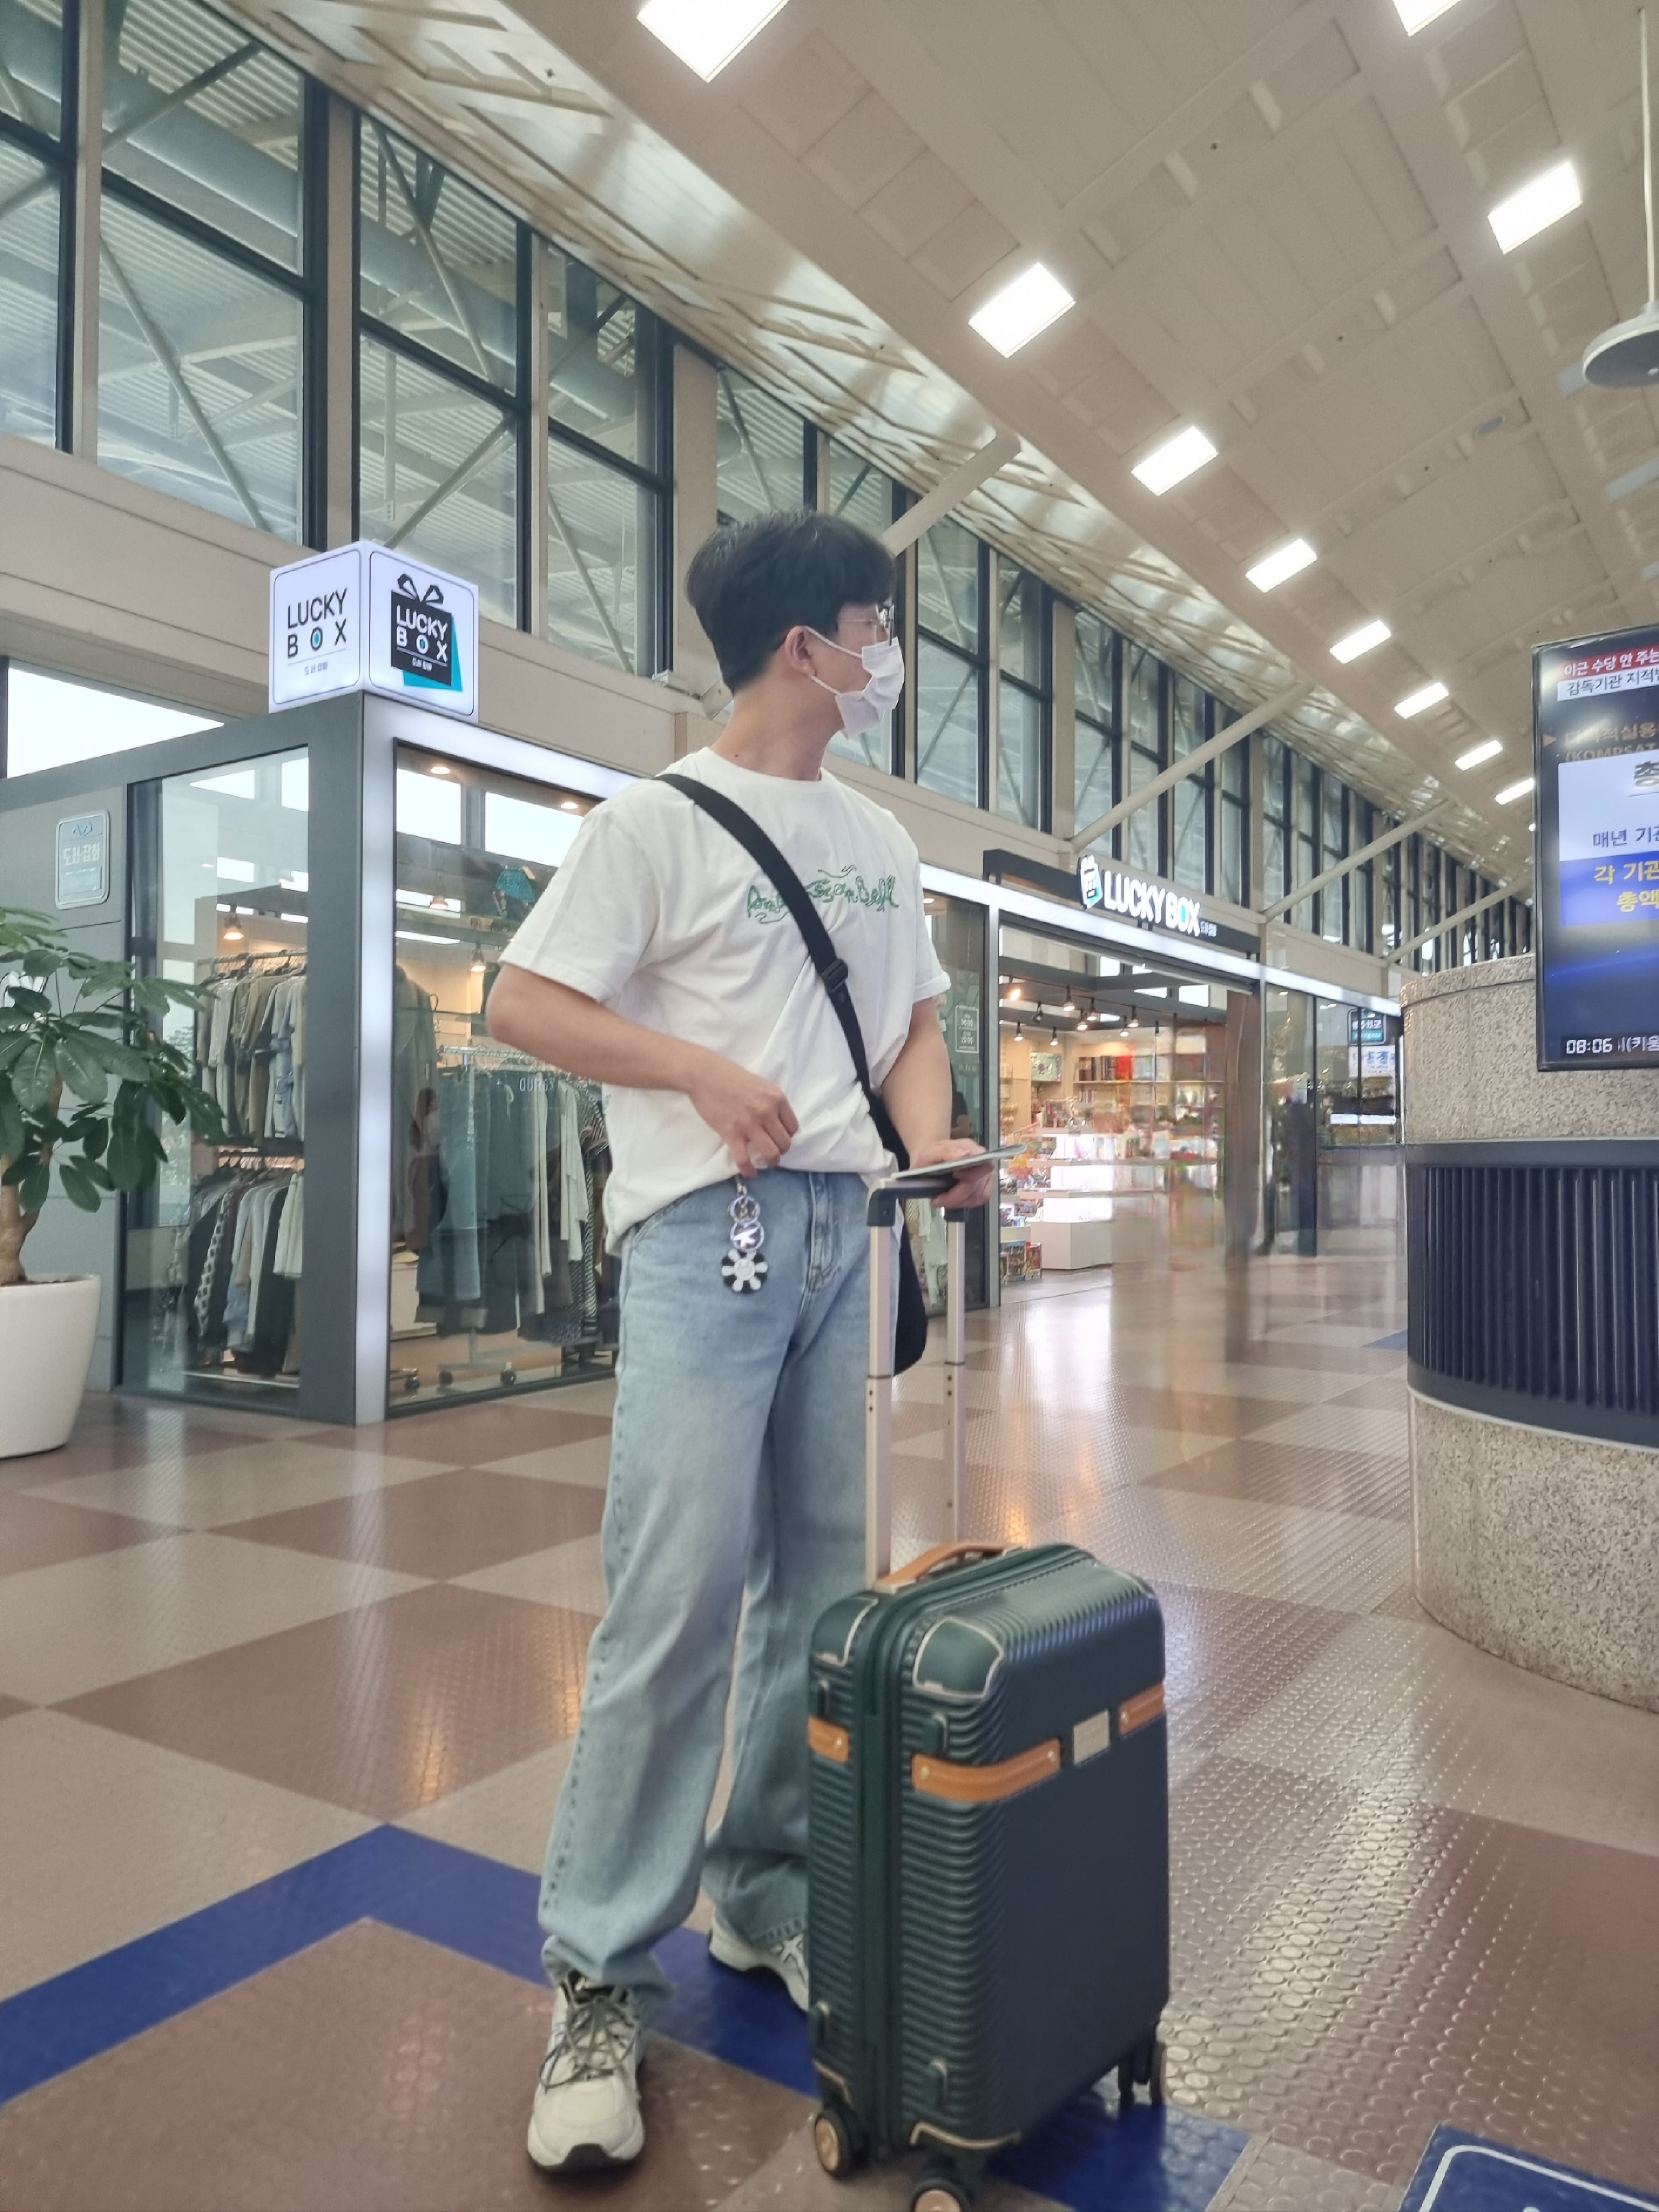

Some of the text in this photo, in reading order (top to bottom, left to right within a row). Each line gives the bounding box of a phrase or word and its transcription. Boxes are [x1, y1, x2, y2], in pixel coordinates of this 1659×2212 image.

[288, 587, 348, 629] LUCKY
[397, 606, 447, 641] LUCKY
[1591, 655, 1616, 673] 수당
[1619, 653, 1633, 668] 안
[1567, 674, 1623, 696] 감독기관
[1593, 829, 1627, 848] 매년
[1594, 865, 1615, 885] 각
[1104, 869, 1201, 937] LUCKY BOX
[1566, 1038, 1613, 1054] 08:06
